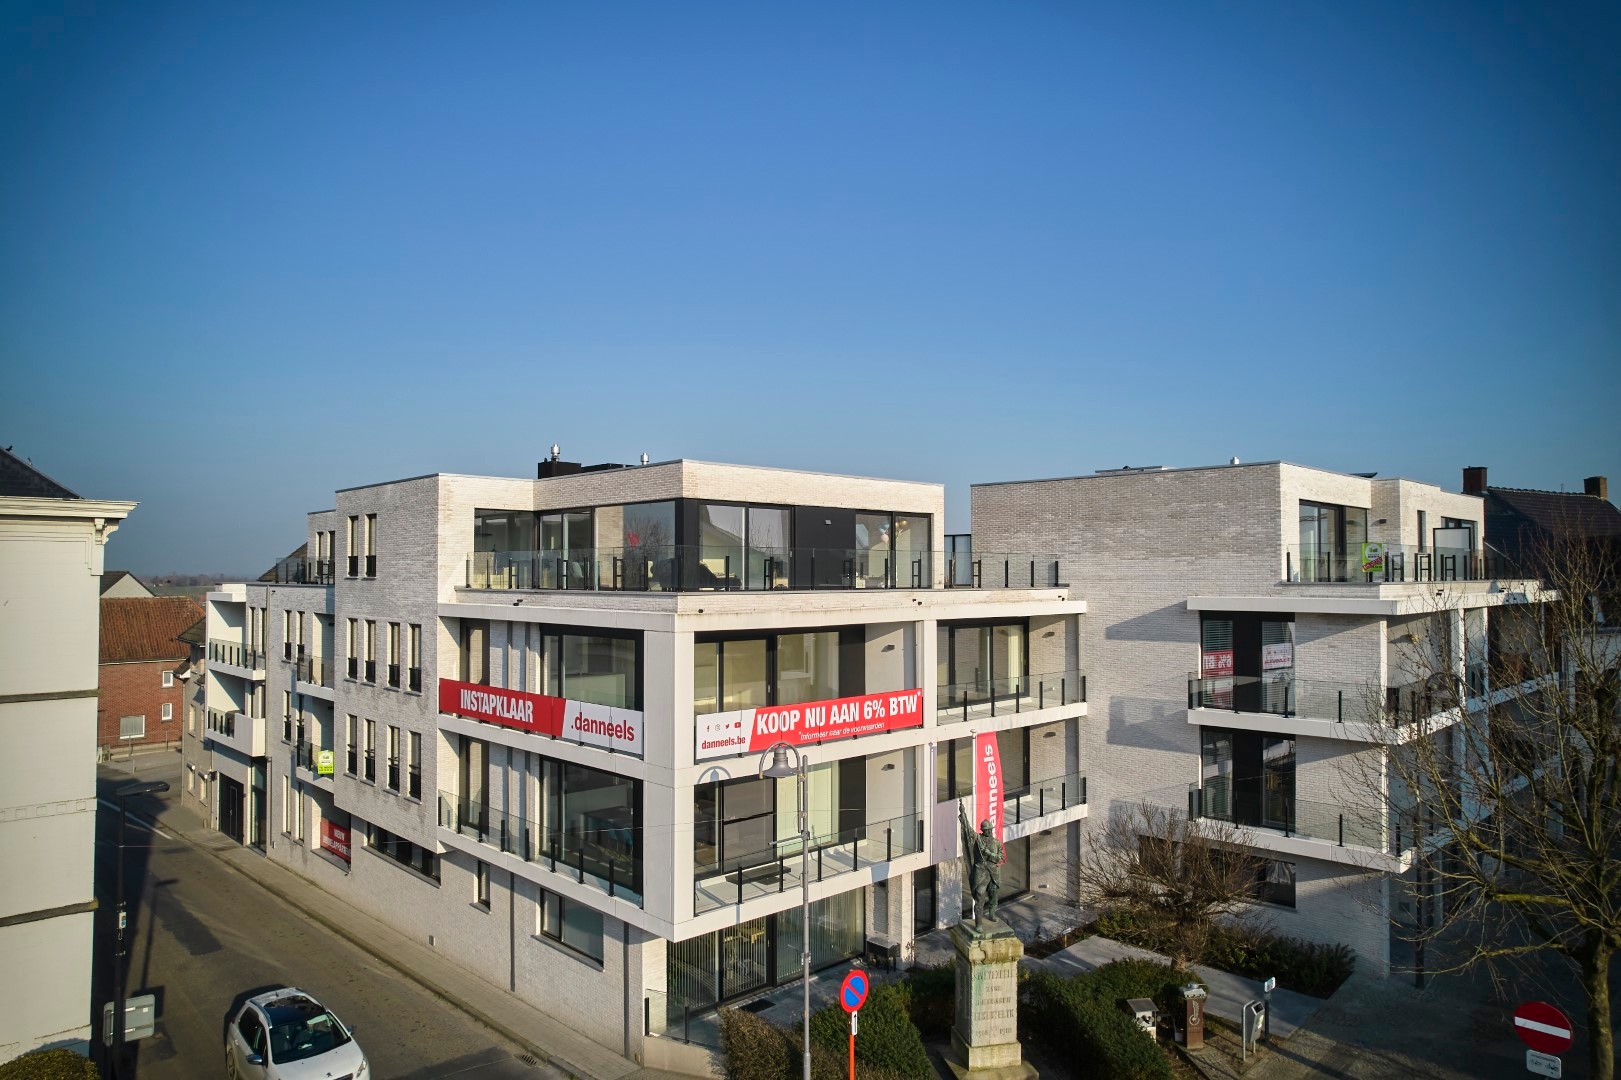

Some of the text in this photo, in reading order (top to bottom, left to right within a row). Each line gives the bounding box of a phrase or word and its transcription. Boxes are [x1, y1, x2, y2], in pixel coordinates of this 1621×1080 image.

[460, 689, 534, 724] INSTAPKLAAR
[757, 709, 800, 736] KOOP
[805, 706, 826, 729] NU
[829, 702, 860, 725] AAN
[863, 699, 886, 720] 6%
[571, 712, 635, 742] .danneels
[701, 735, 747, 751] danneels.be
[829, 729, 841, 737] naar
[842, 726, 850, 735] de
[850, 722, 885, 734] voorwaarden
[984, 744, 997, 839] anneels
